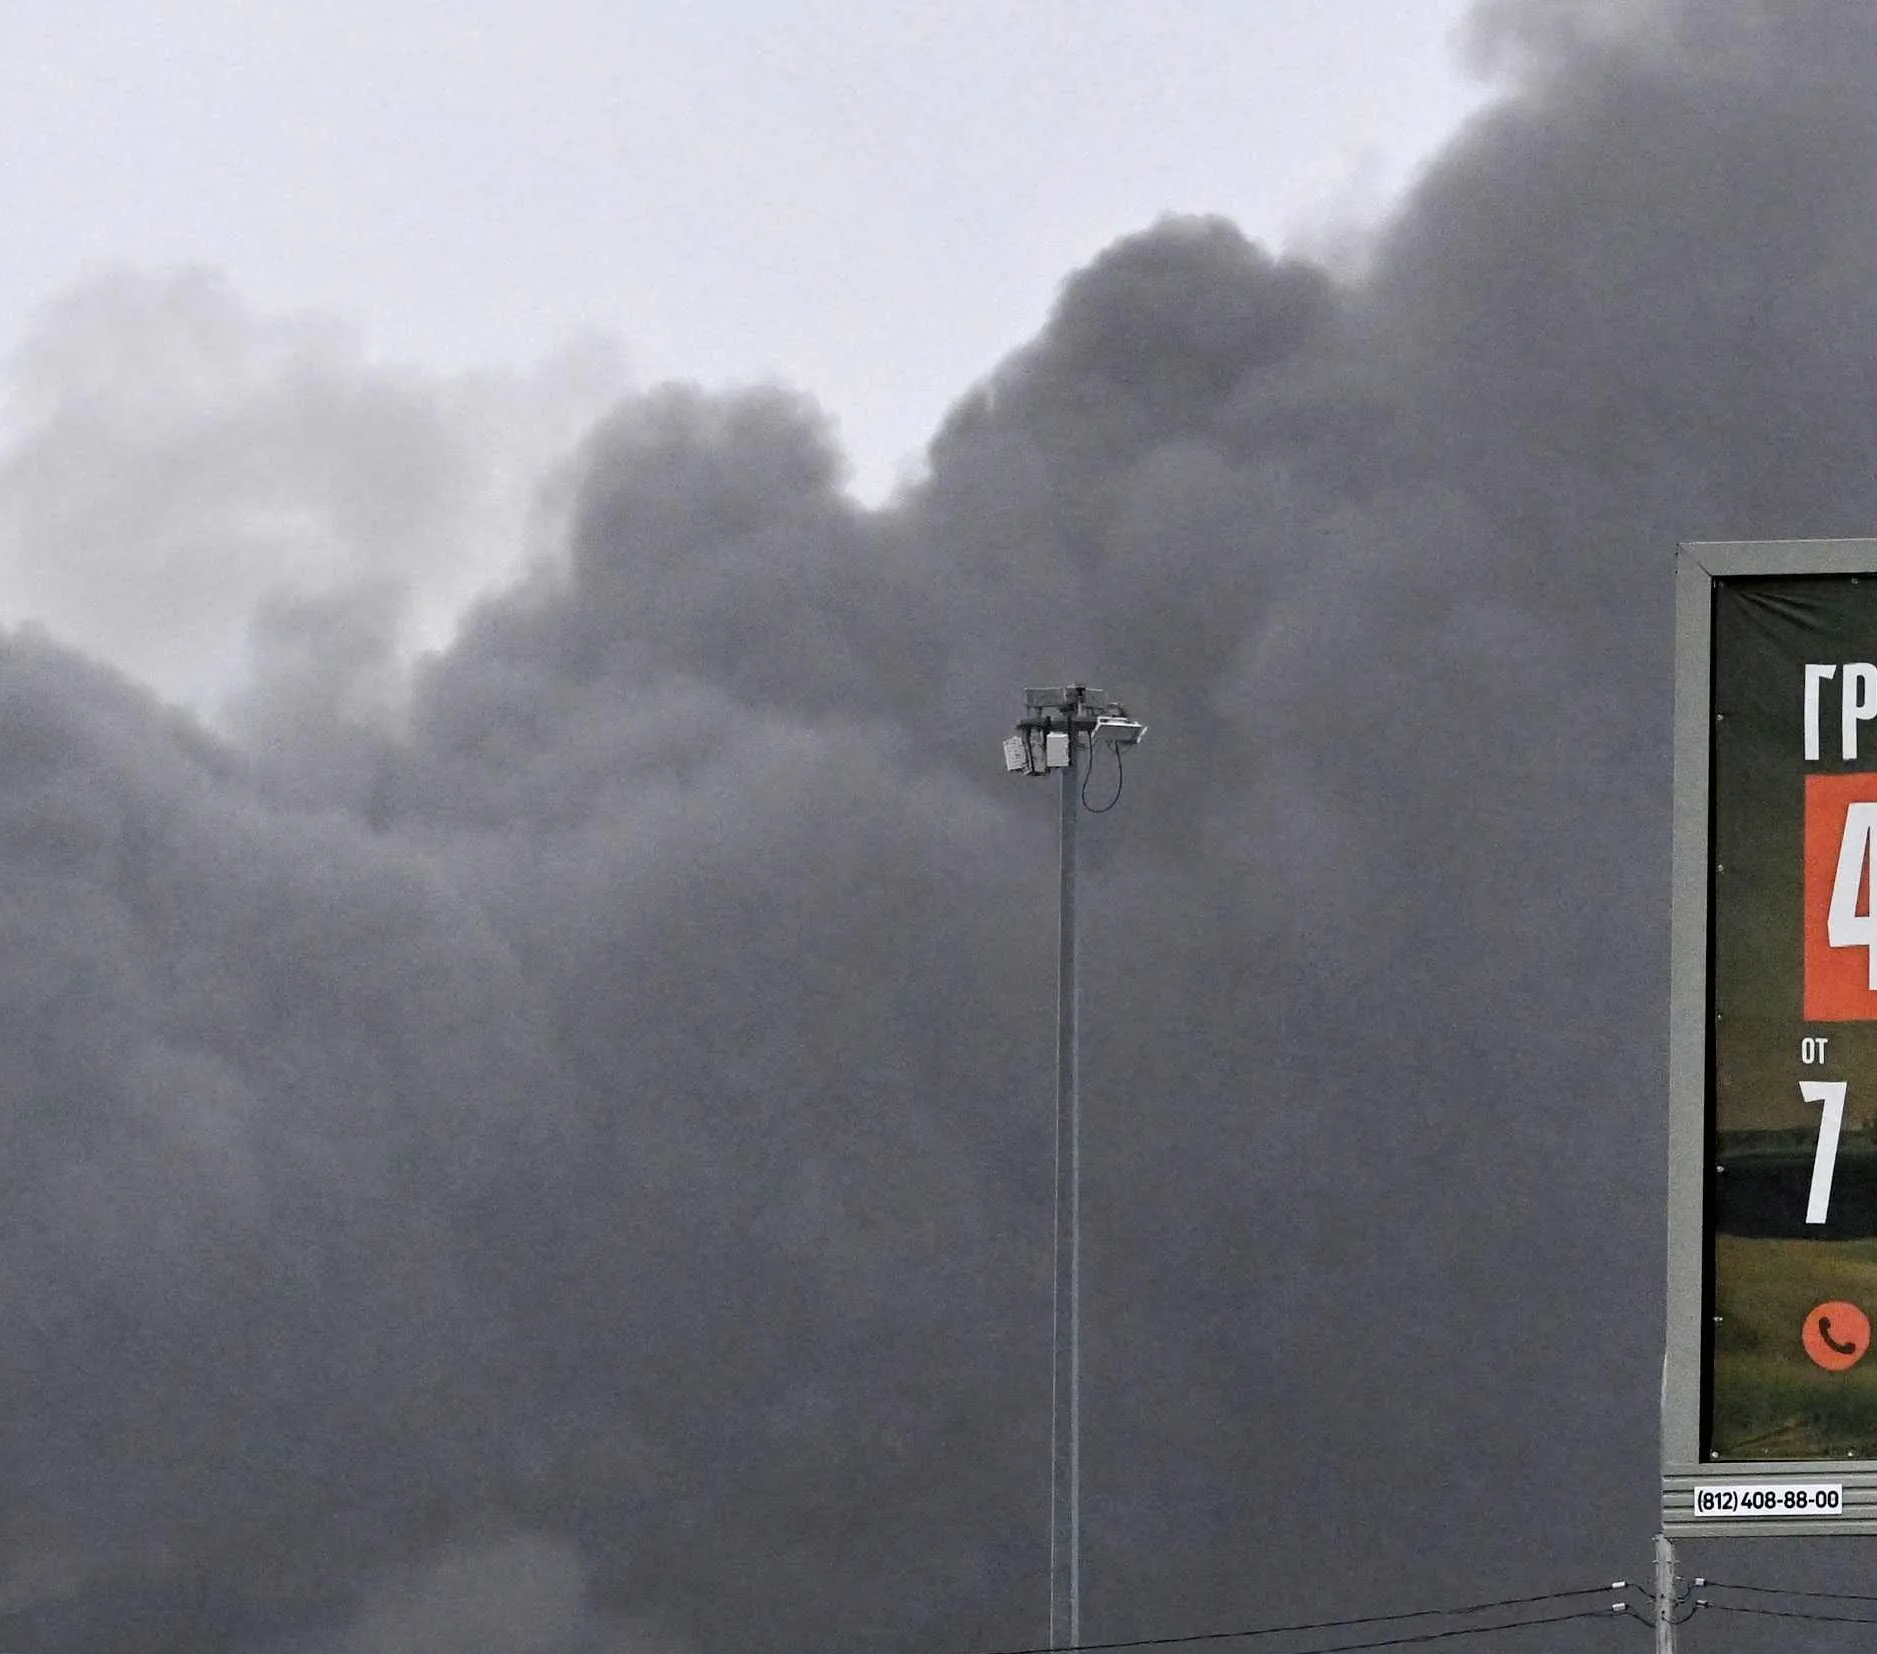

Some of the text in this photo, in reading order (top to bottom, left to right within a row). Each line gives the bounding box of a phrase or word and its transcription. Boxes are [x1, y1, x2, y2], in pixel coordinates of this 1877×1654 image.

[1801, 1037, 1829, 1065] ОТ
[1798, 1081, 1847, 1224] 7
[1697, 1490, 1839, 1512] (812) 408-88-00
